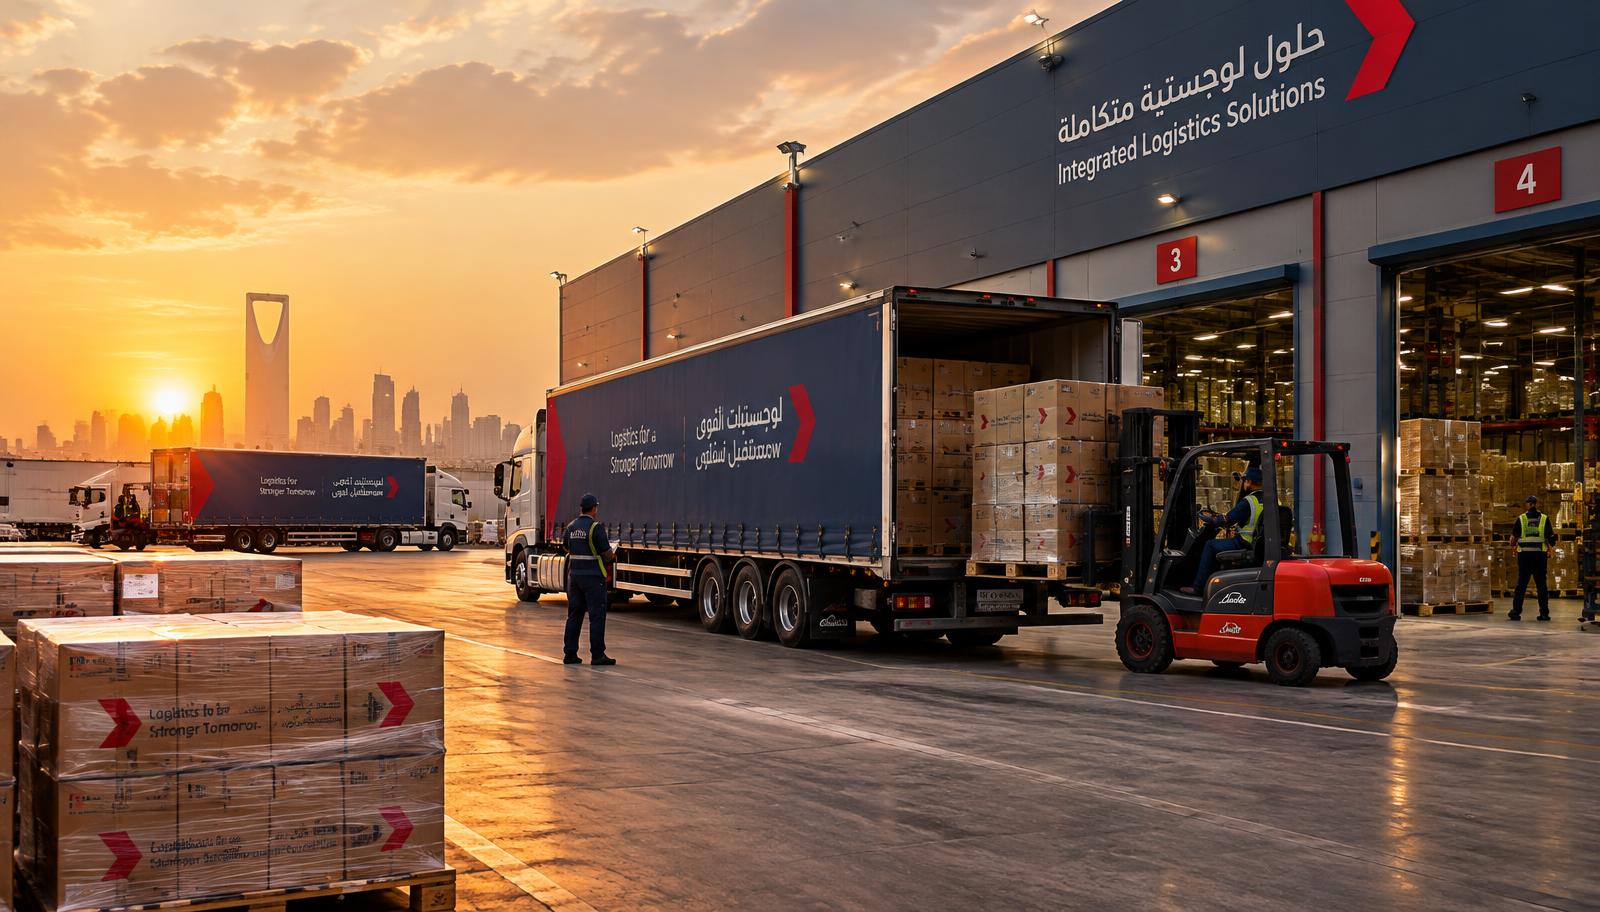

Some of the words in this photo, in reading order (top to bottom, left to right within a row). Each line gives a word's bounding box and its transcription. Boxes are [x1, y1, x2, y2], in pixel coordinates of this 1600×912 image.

[1254, 22, 1325, 80] حلول
[1140, 45, 1245, 117] لوجستية
[1057, 97, 1134, 144] متكاملة
[1058, 135, 1137, 185] Integrated
[1142, 112, 1221, 156] Logistics
[1226, 77, 1326, 128] Solutions
[1516, 163, 1537, 194] 4
[1170, 247, 1182, 272] 3
[639, 425, 650, 444] for
[639, 452, 675, 470] Tomorrow
